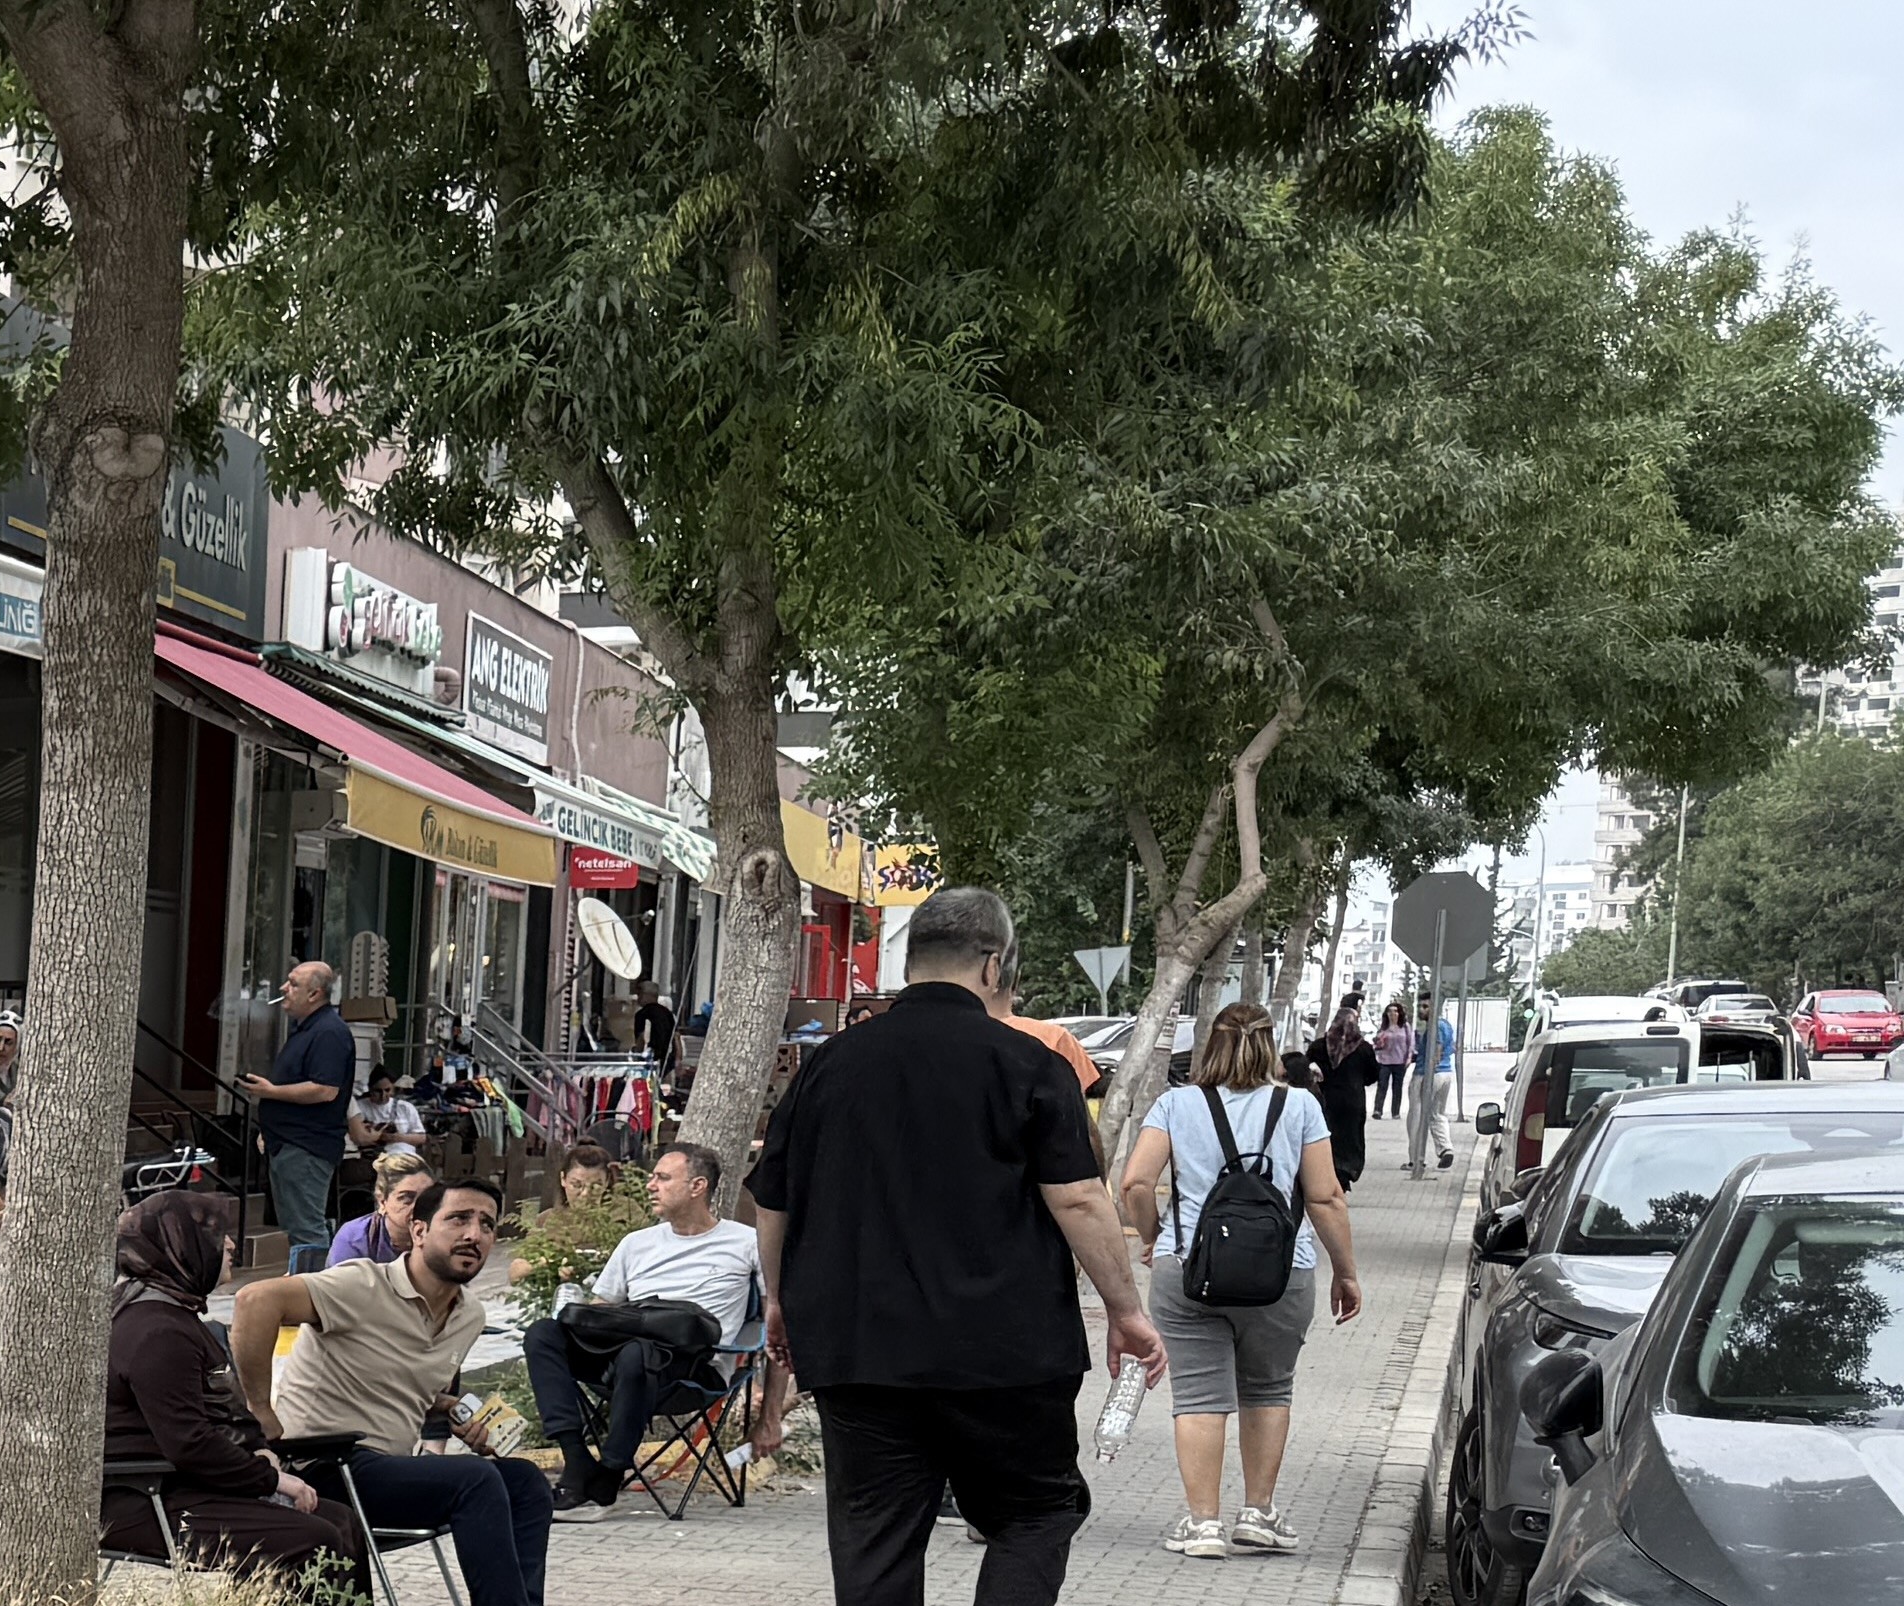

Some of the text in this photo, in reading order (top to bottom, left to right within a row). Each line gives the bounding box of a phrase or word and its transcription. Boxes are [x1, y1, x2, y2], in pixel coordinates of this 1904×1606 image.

[181, 481, 248, 572] Güzellik
[472, 632, 498, 692] ANG
[500, 647, 549, 715] ELEKTRİK
[557, 805, 609, 848] GELİNCİK
